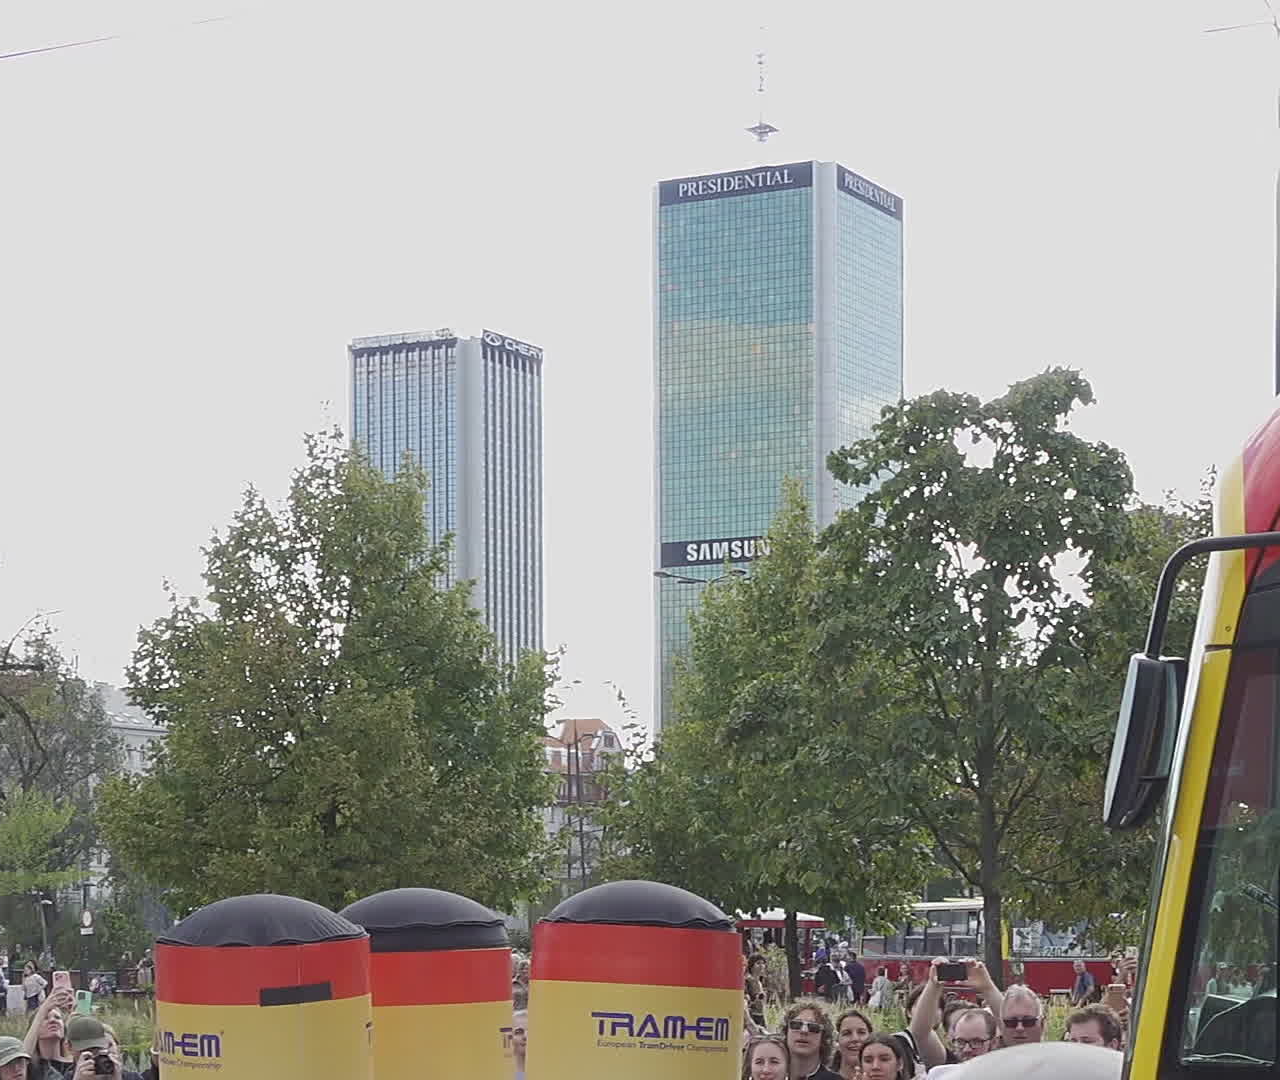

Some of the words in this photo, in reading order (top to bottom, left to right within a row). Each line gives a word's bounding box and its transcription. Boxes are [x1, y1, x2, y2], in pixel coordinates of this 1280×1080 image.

[678, 168, 794, 198] PRESIDENTIAL
[844, 171, 897, 213] PRESIDENTIAL
[686, 537, 772, 562] SAMSUN
[592, 1012, 729, 1041] TRAM-EM
